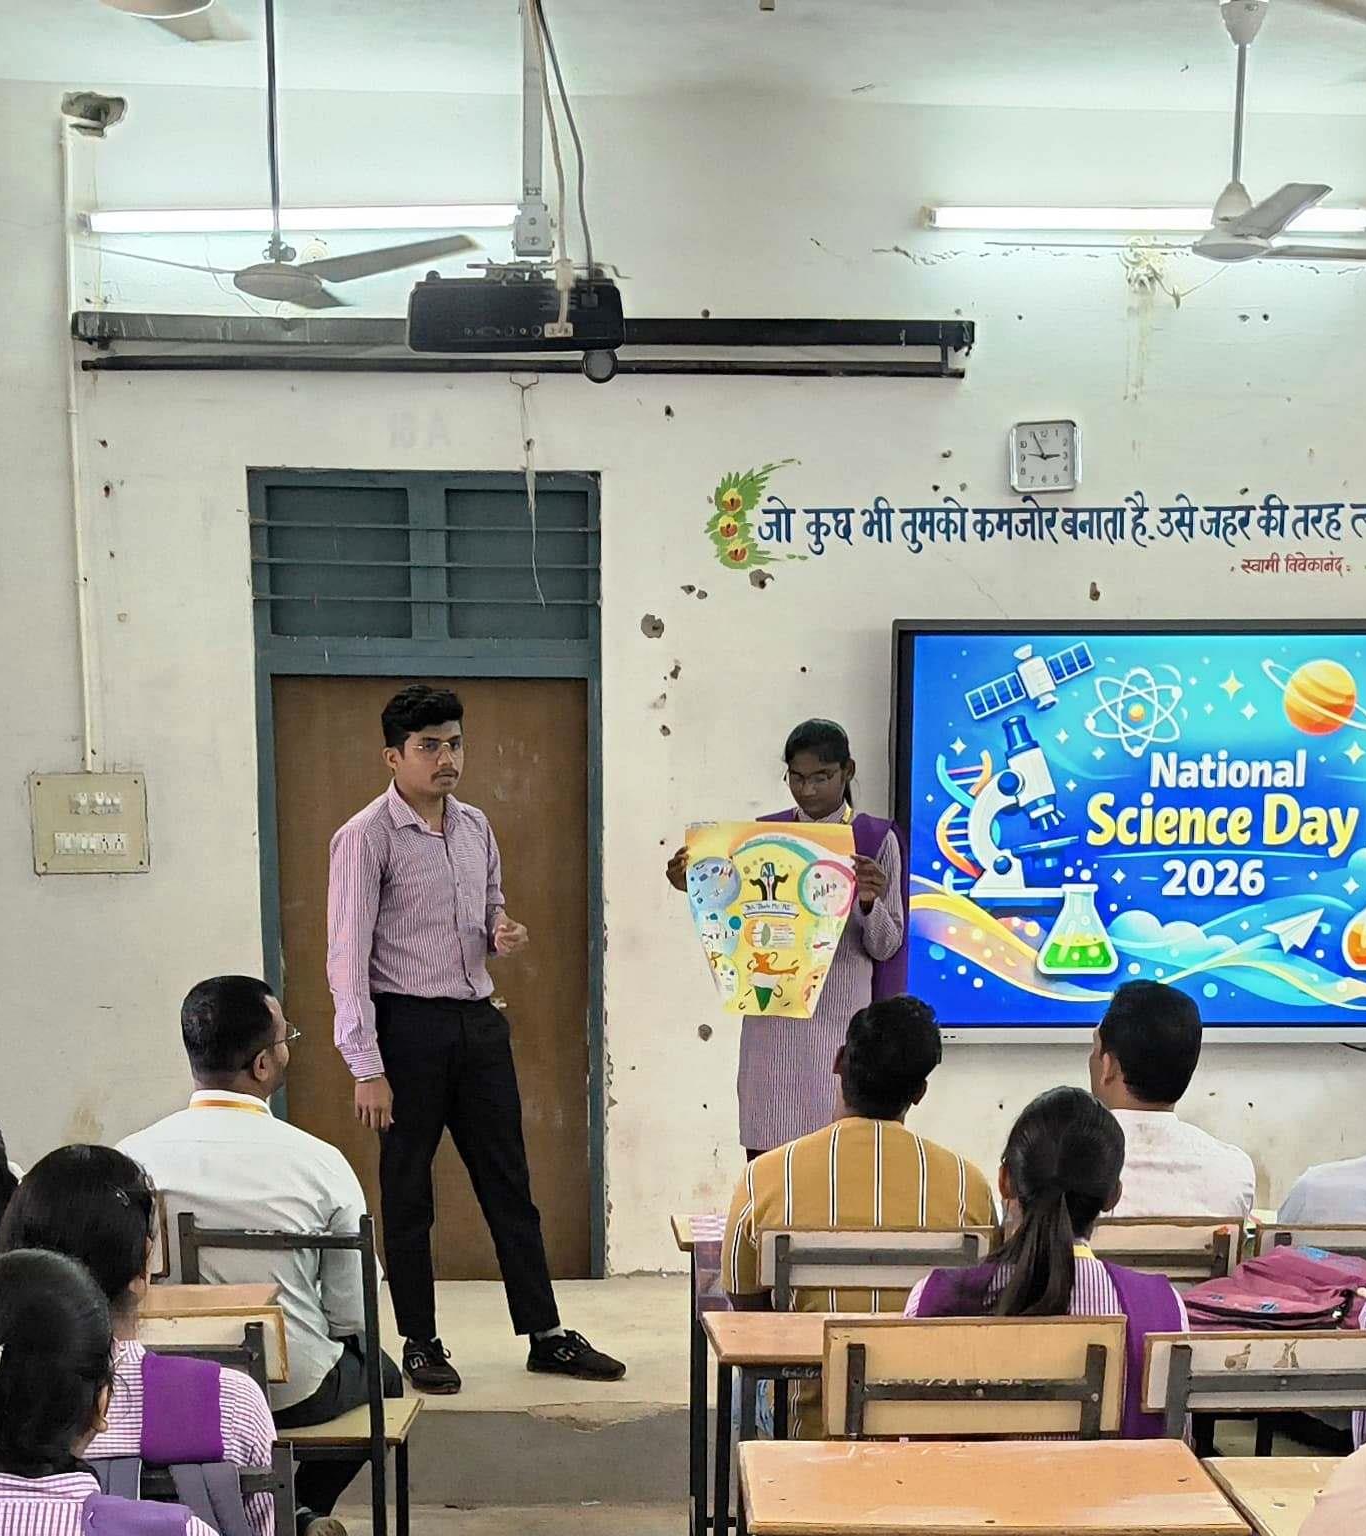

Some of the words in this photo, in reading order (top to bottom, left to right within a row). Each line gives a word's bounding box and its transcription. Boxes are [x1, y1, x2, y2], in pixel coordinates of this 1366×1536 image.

[758, 495, 796, 544] जो
[802, 507, 855, 556] कुछ
[860, 496, 896, 543] भी
[899, 495, 969, 554] तुमको
[971, 494, 1059, 545] कमजोर
[1061, 506, 1126, 545] बनाता
[1156, 493, 1199, 543] उसे
[1200, 504, 1257, 548] जहर
[1256, 493, 1290, 538] की
[1291, 503, 1345, 541] तरह
[1240, 551, 1280, 574] स्वामी
[1149, 750, 1306, 789] National
[1086, 793, 1252, 846] Science
[1261, 793, 1360, 858] Day
[1161, 858, 1266, 897] 2026
